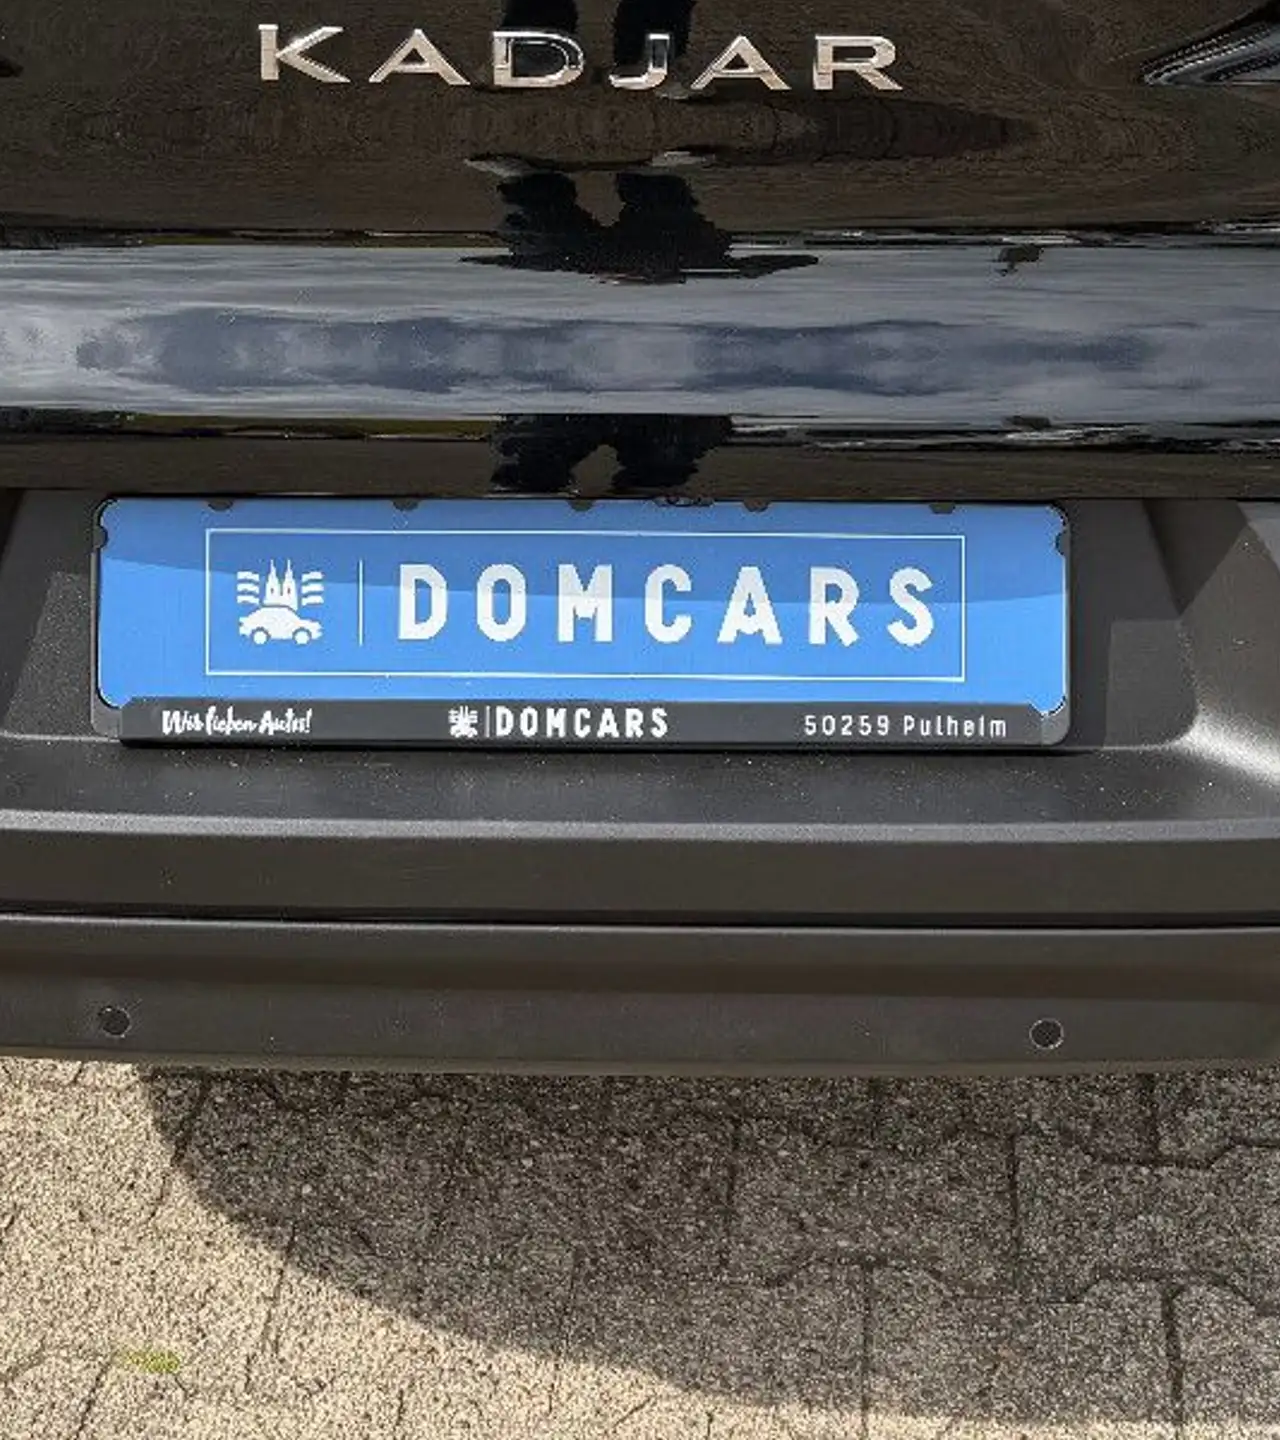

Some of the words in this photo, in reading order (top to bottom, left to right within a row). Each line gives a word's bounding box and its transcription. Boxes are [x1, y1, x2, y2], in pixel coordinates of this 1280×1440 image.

[257, 23, 904, 92] KADJAR
[397, 563, 935, 647] DOMCARS
[495, 706, 669, 738] DOMCARS
[804, 715, 889, 736] 50259
[903, 715, 1007, 737] Pulheim
